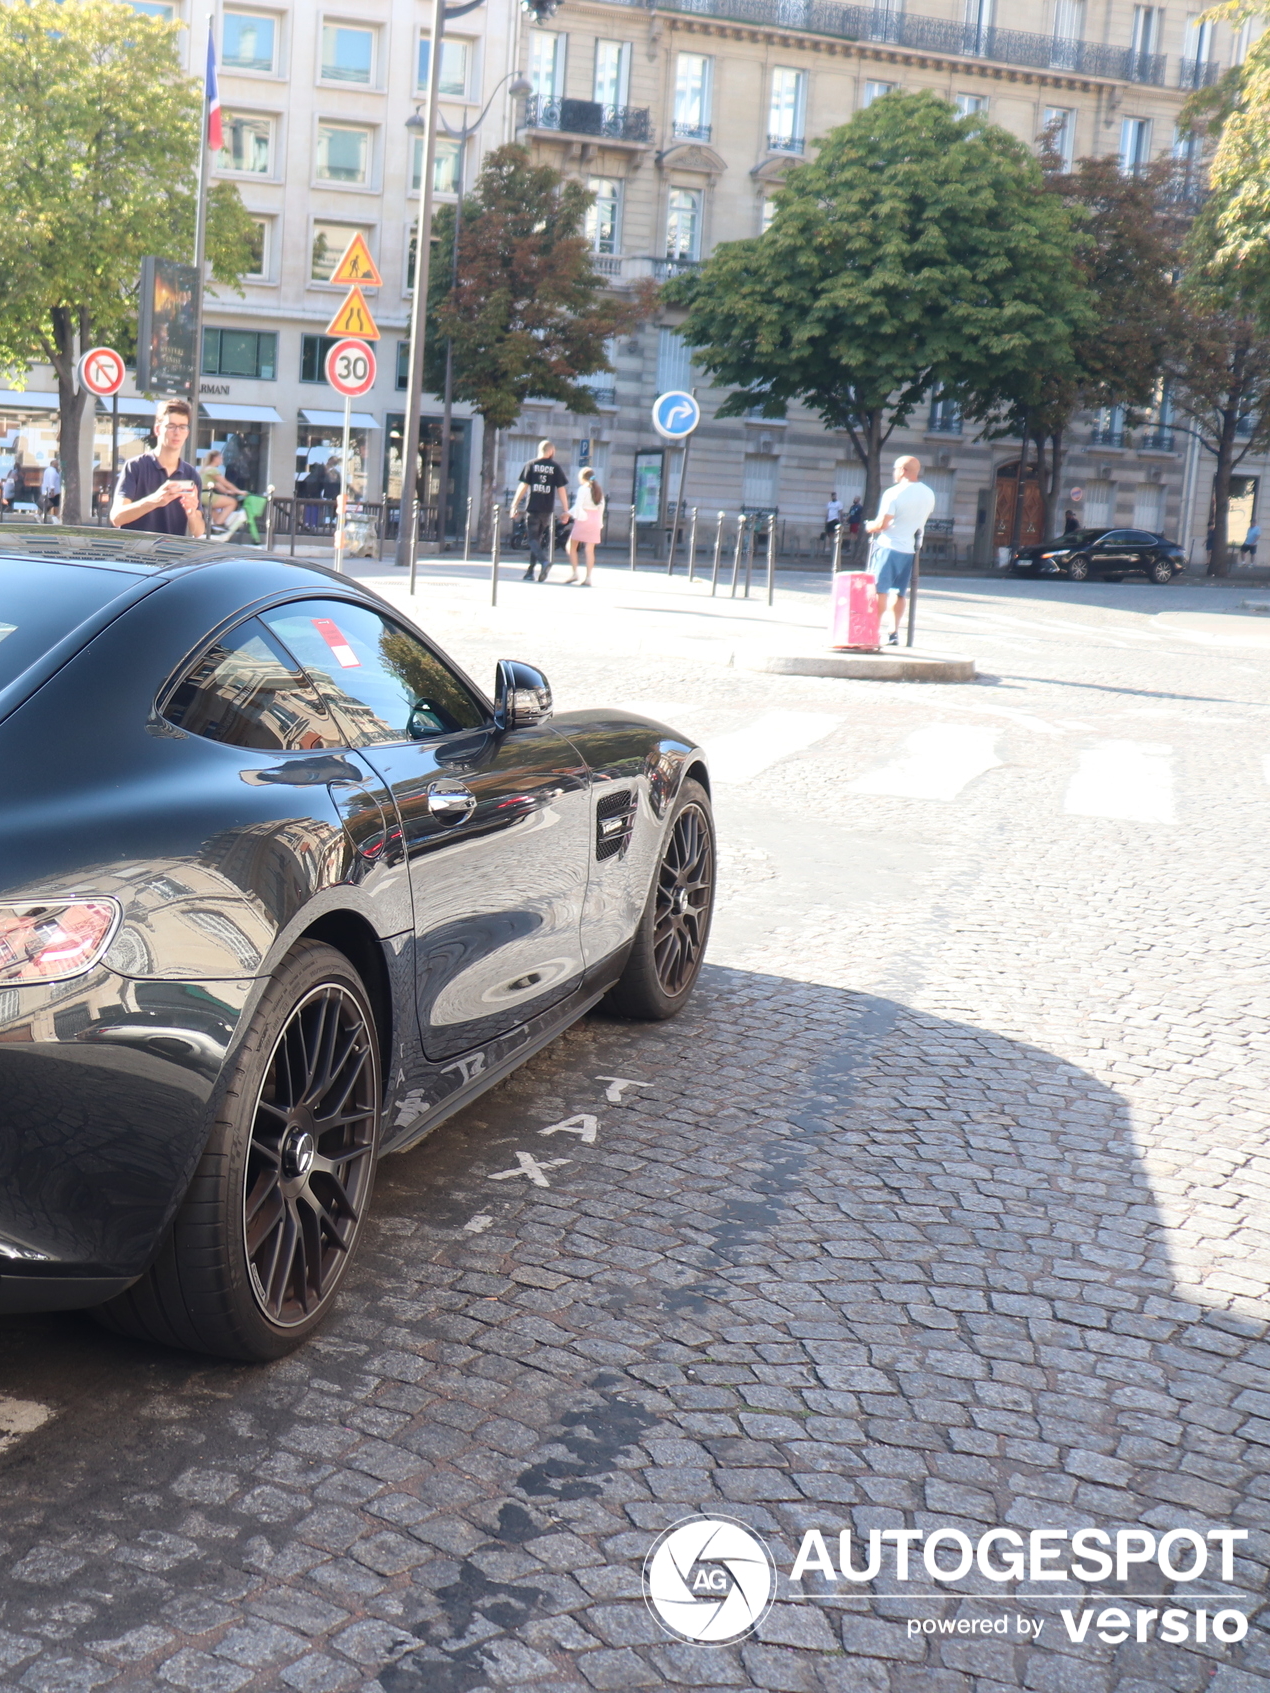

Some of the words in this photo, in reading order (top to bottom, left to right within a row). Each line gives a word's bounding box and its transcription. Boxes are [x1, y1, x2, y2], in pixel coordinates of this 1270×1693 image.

[338, 355, 368, 380] 30
[582, 441, 588, 454] P
[534, 464, 555, 475] ROCK
